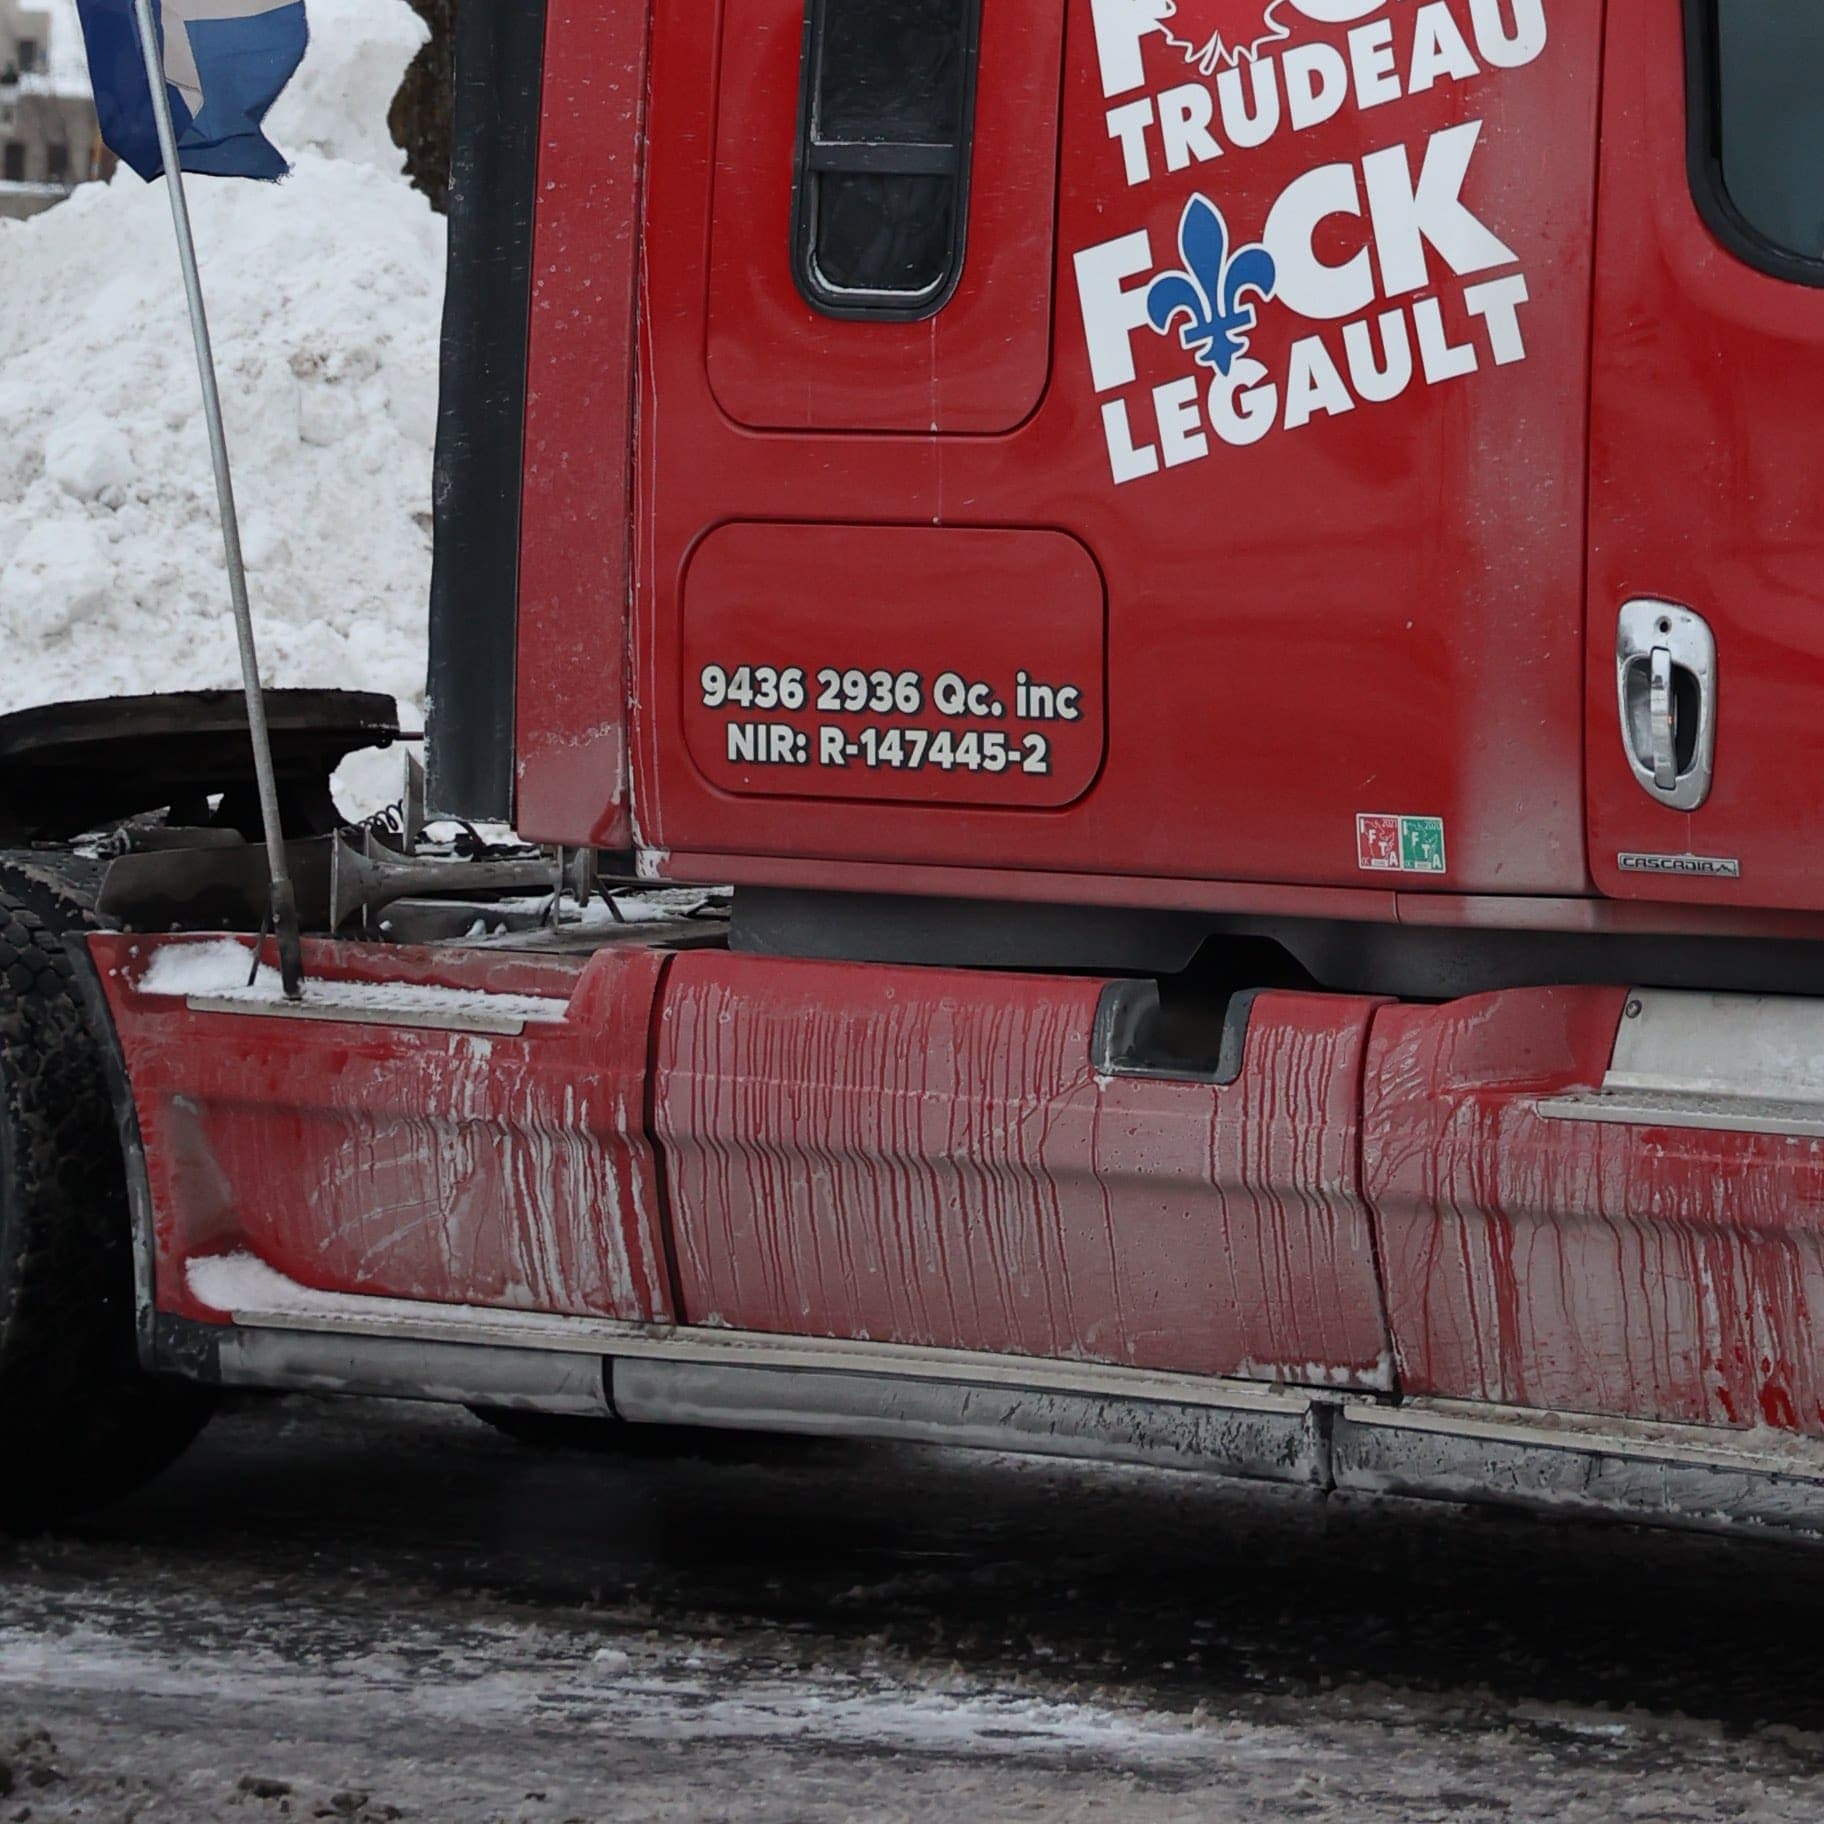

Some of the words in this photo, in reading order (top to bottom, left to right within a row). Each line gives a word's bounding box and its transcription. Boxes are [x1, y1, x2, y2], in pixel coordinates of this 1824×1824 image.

[1101, 273, 1529, 485] LEGAULT
[701, 666, 804, 709] 9436
[816, 668, 921, 714] 2936
[933, 671, 1003, 718] Qc.
[1016, 672, 1080, 720] inc
[727, 723, 807, 764] NIR:
[820, 726, 1048, 773] R-147445-2
[1623, 856, 1714, 872] CASCADIA
